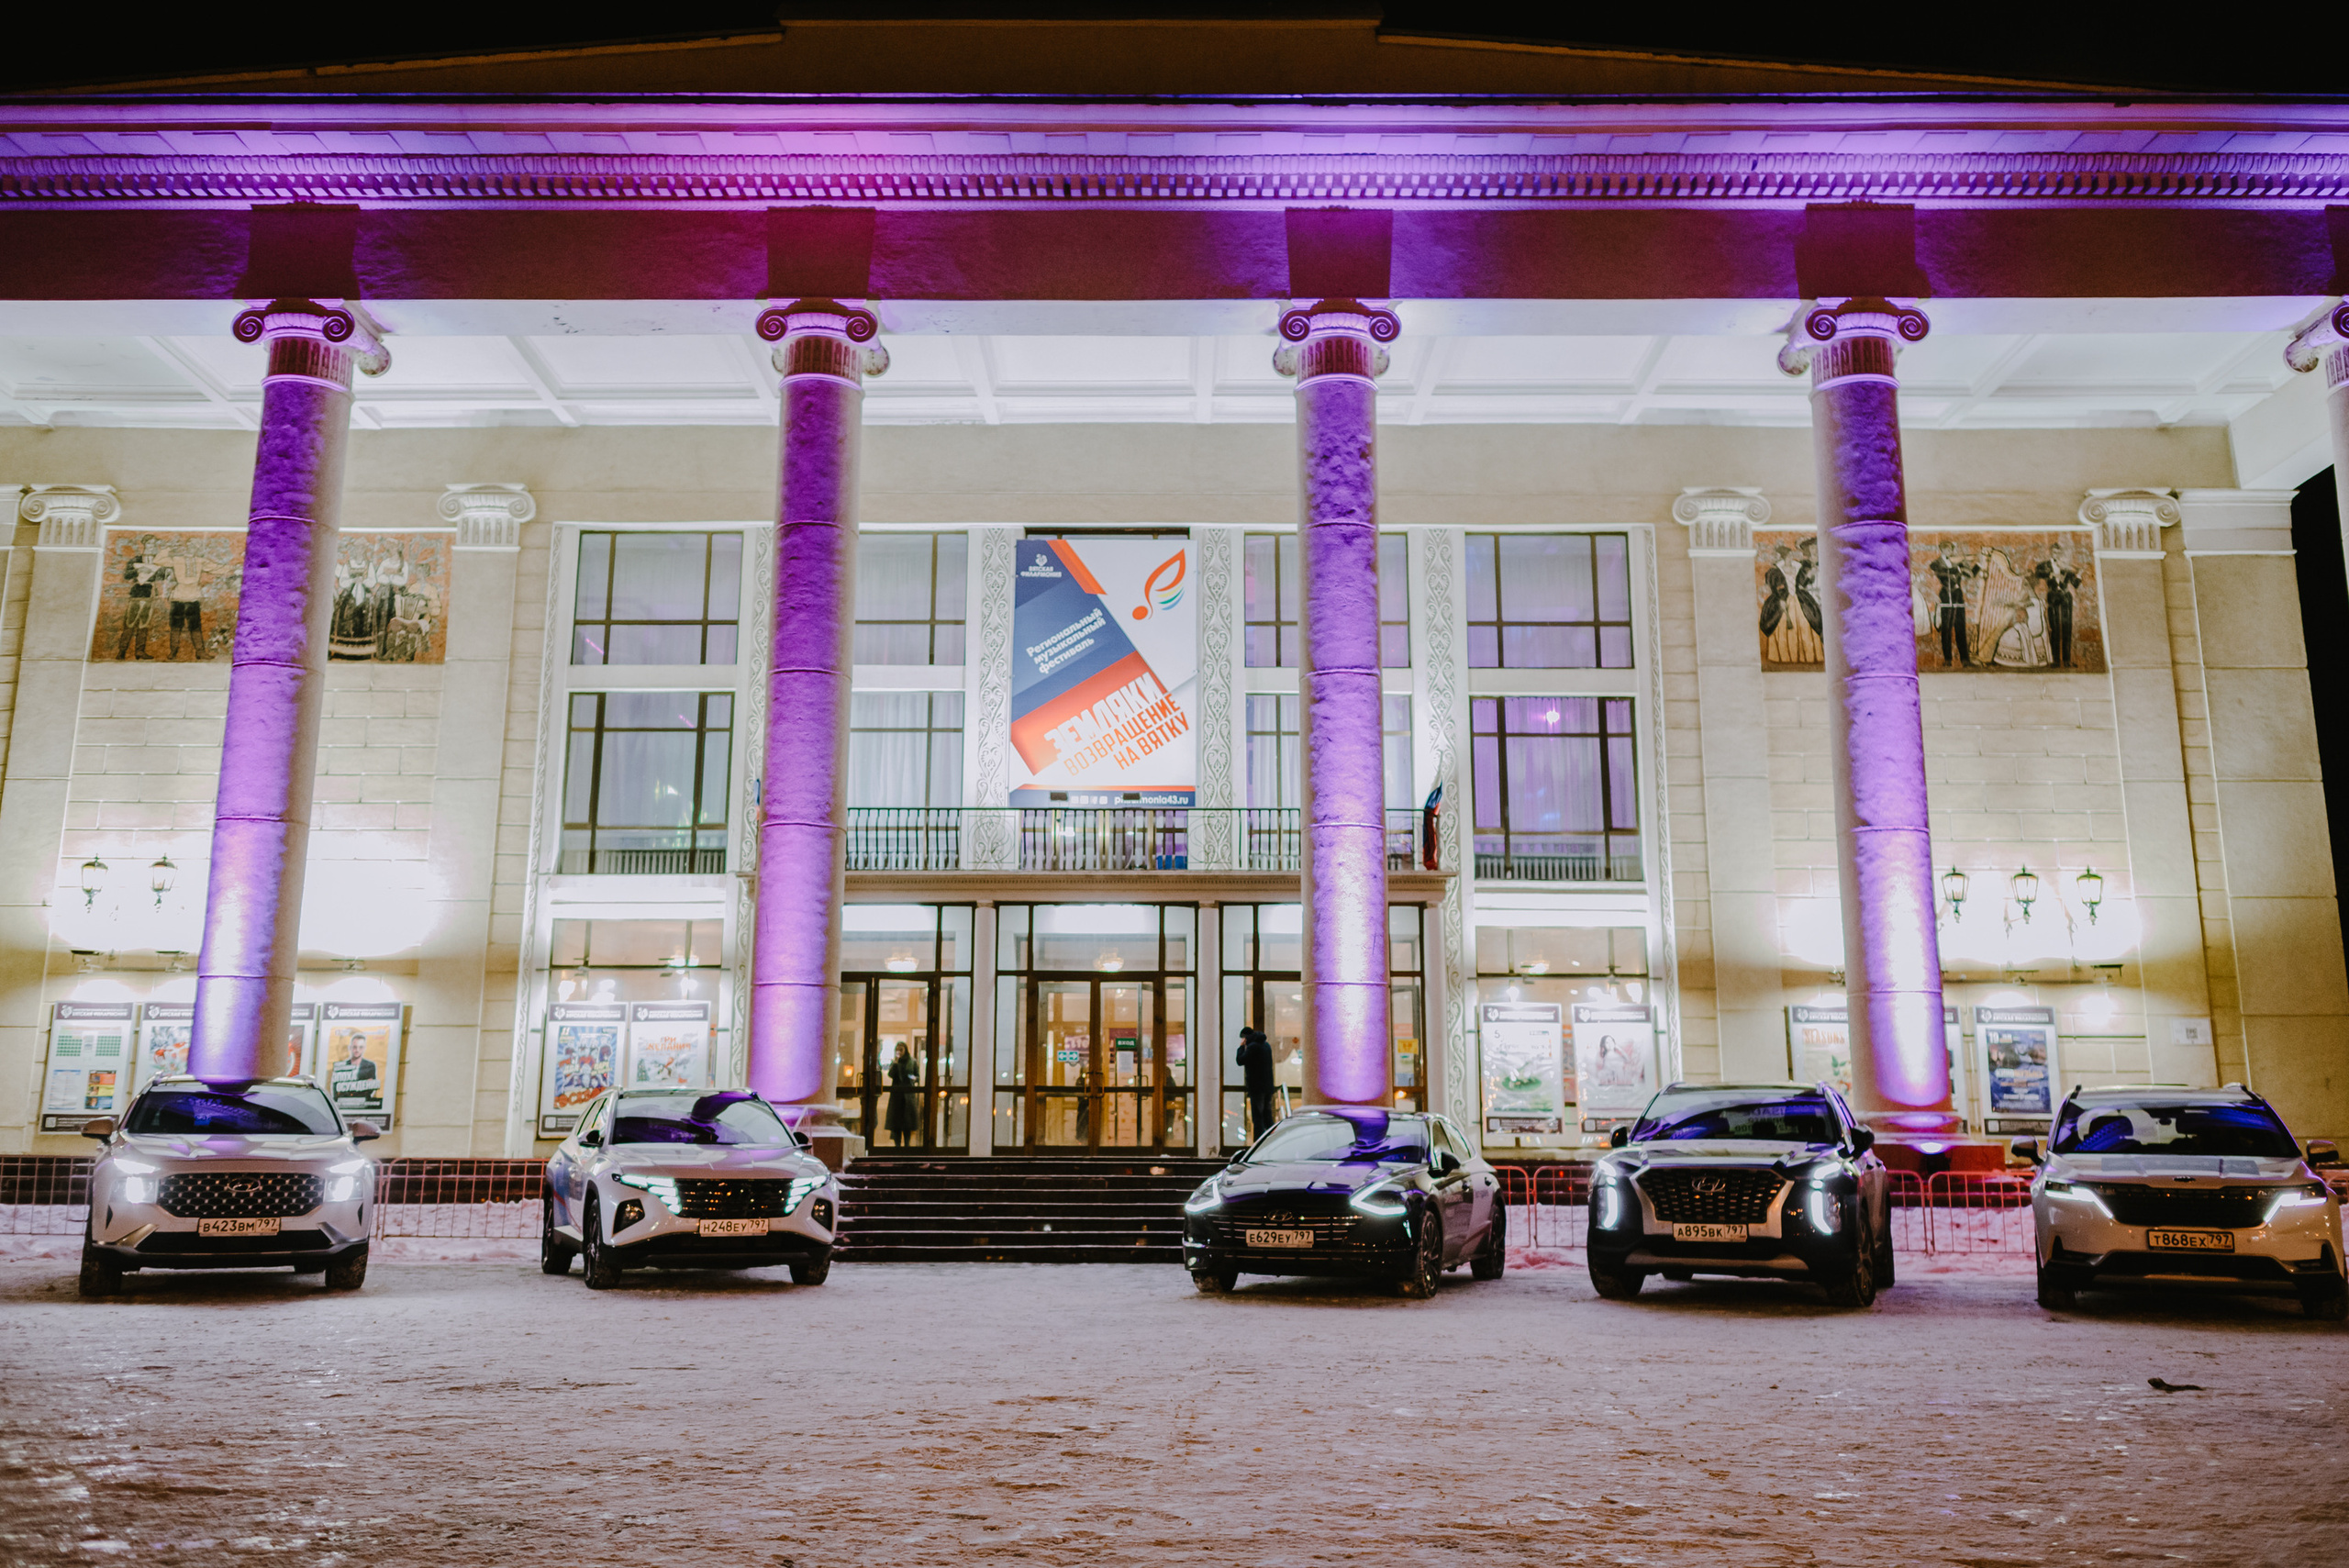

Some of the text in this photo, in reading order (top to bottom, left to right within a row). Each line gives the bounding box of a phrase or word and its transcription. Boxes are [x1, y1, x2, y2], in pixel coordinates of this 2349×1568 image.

[1026, 607, 1103, 657] Региональный
[1034, 617, 1107, 664] музыкальный
[1039, 638, 1095, 673] фестиваль
[1043, 672, 1164, 761] ЗЕМЛЯКИ
[1063, 693, 1181, 776] ВОЗВРАЩЕНИЕ
[1113, 712, 1189, 770] НА ВЯТКУ
[258, 1219, 276, 1228] 797
[750, 1220, 765, 1229] 797
[1294, 1231, 1310, 1240] 797
[1726, 1225, 1743, 1234] 797
[2209, 1234, 2229, 1245] 797
